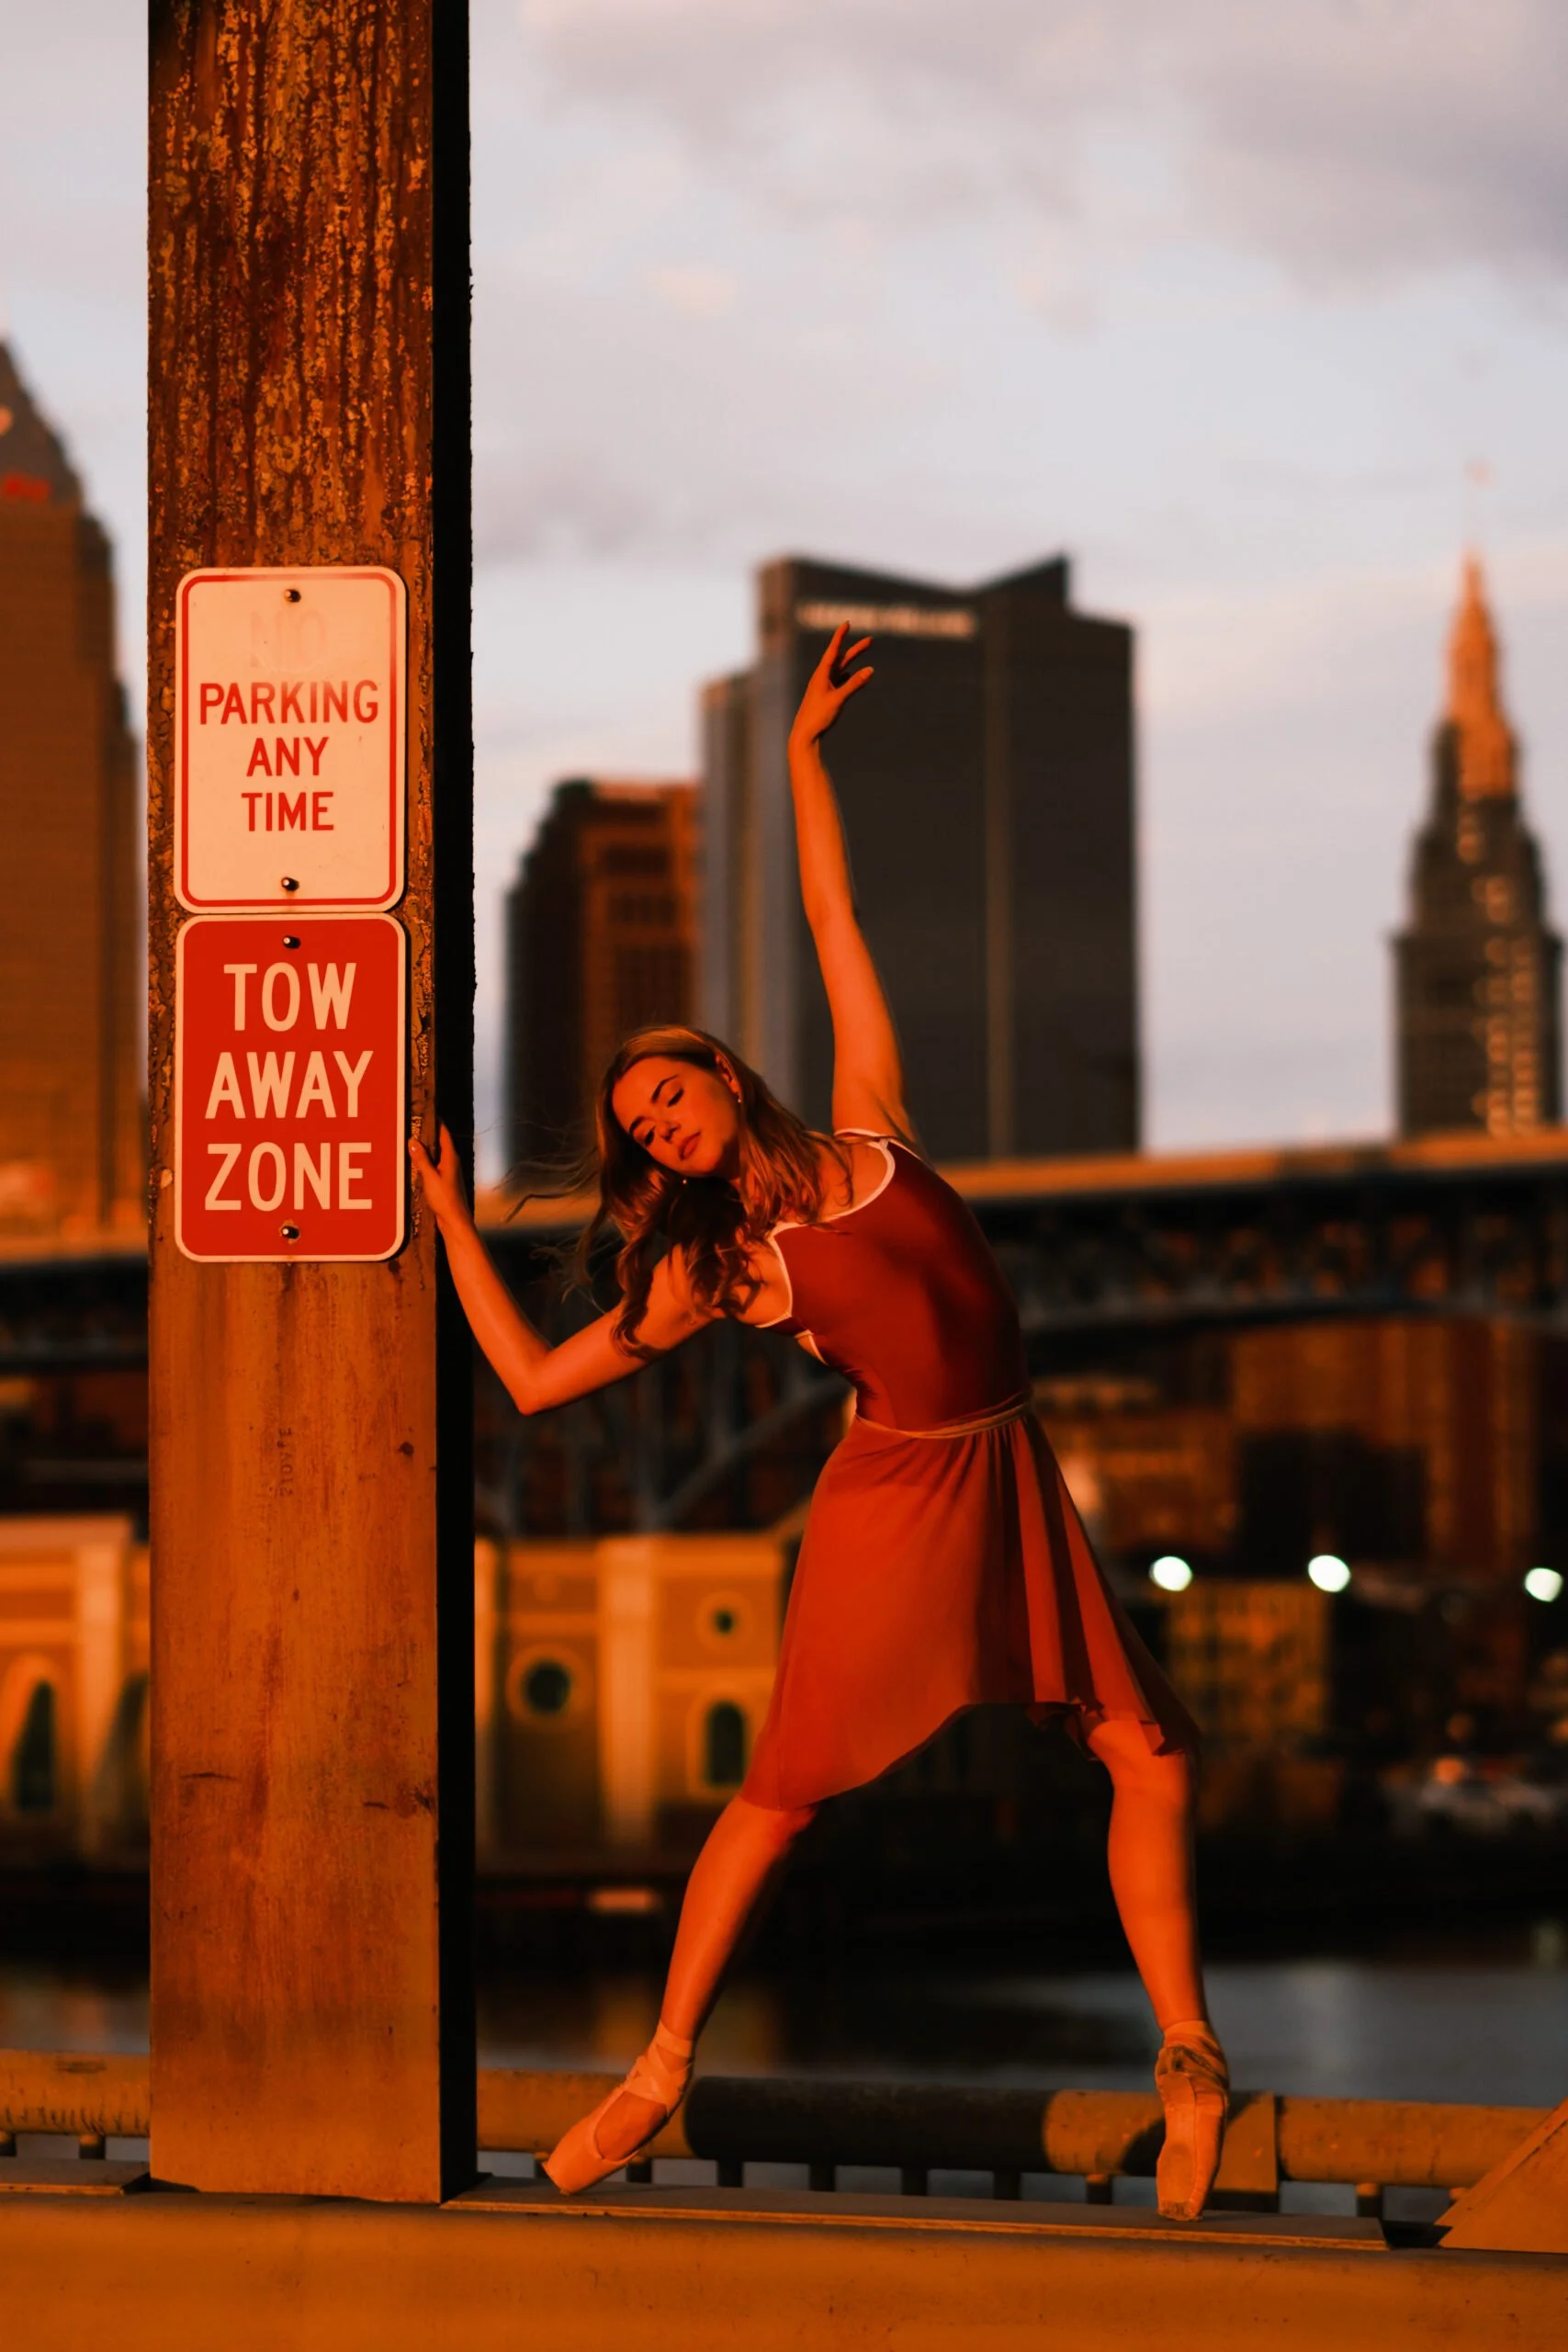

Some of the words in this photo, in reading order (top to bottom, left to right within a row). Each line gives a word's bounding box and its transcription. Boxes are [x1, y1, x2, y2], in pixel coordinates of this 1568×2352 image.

[200, 680, 378, 725] PARKING
[246, 737, 329, 777] ANY
[241, 791, 334, 831] TIME
[224, 963, 355, 1031] TOW
[206, 1051, 373, 1118] AWAY
[206, 1142, 372, 1211] ZONE
